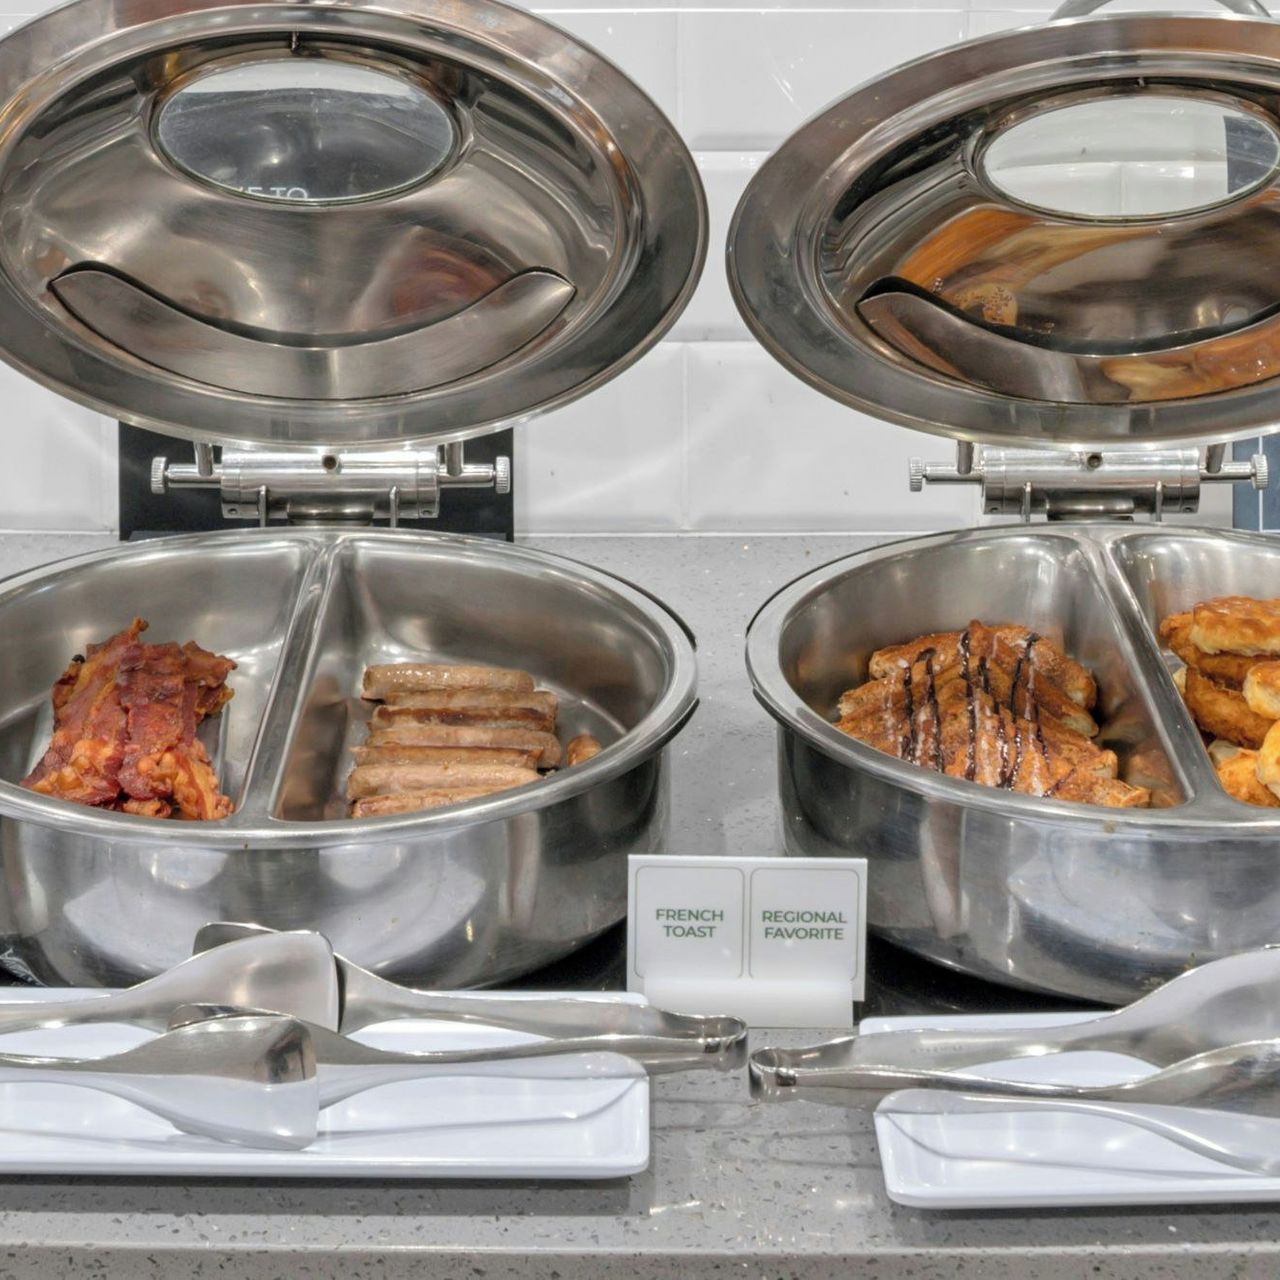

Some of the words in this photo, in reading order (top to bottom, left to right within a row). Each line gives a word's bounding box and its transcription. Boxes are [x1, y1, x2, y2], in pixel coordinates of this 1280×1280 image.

[656, 909, 723, 921] FRENCH
[763, 911, 846, 923] REGIONAL
[664, 926, 716, 937] TOAST
[765, 927, 843, 939] FAVORITE
